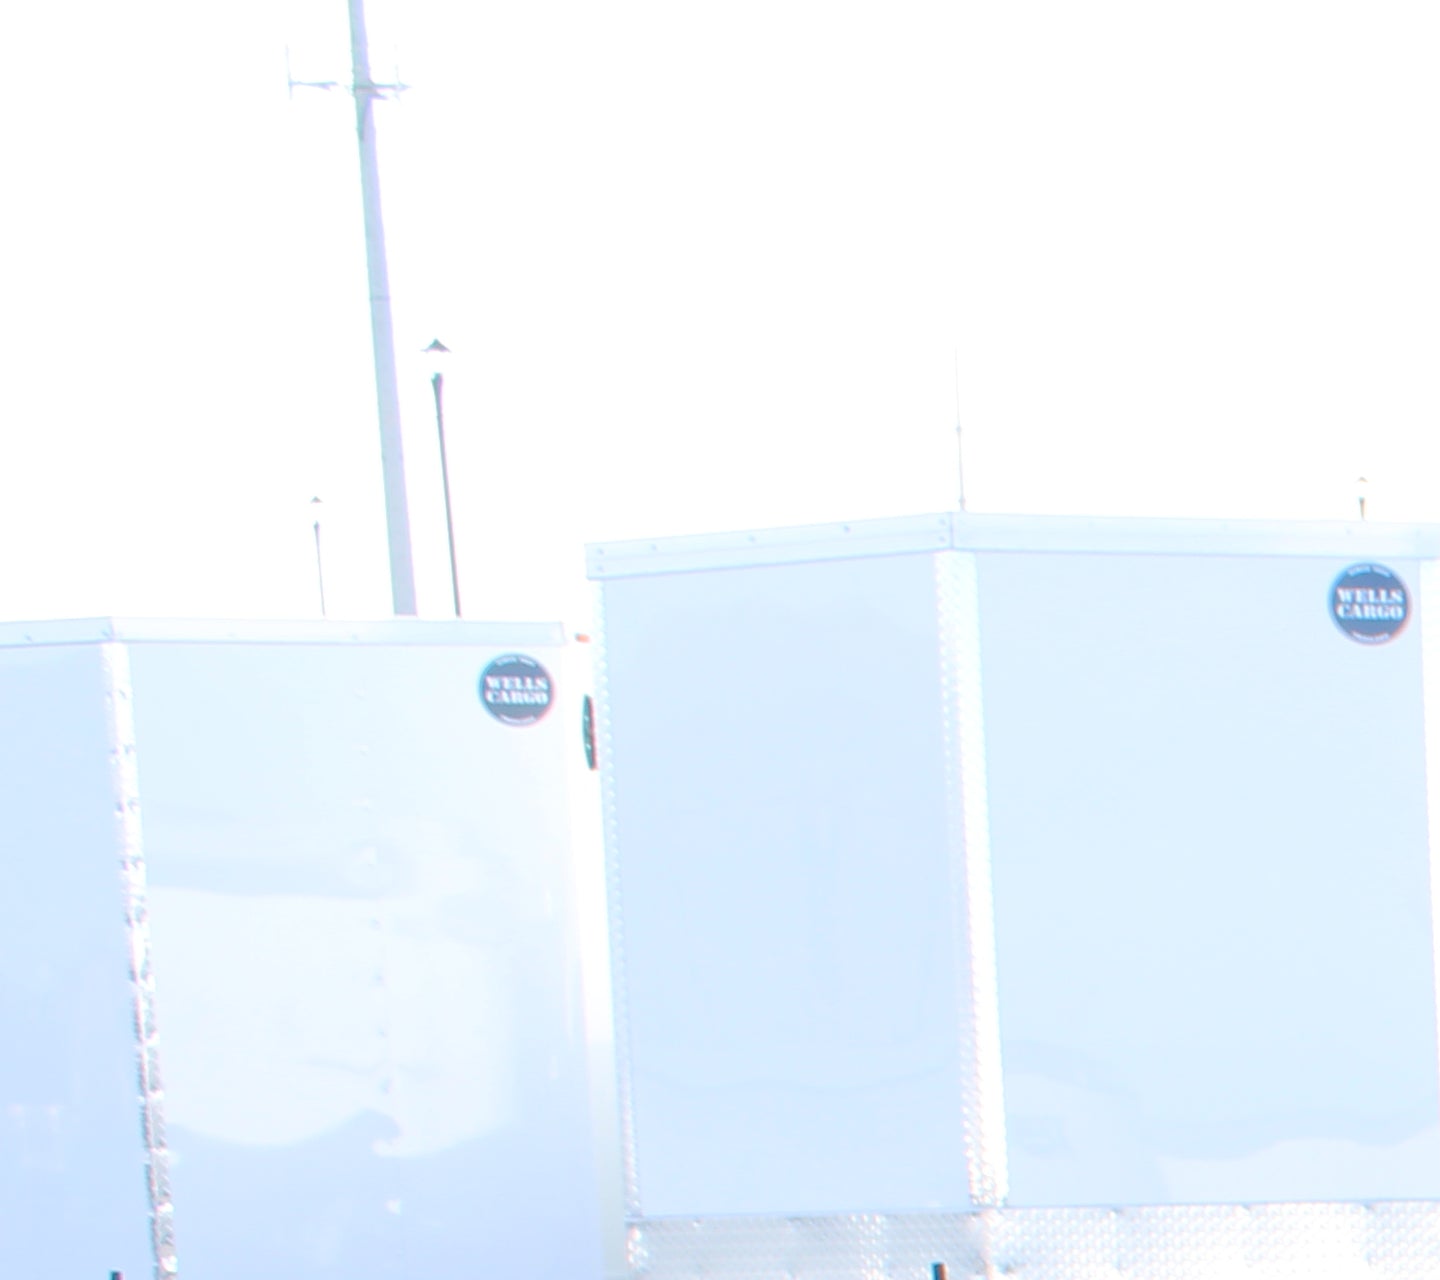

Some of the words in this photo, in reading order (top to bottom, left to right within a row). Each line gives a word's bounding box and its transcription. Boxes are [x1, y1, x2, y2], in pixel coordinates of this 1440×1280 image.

[1337, 587, 1404, 603] WELLS
[1336, 603, 1404, 620] CARGO
[485, 675, 549, 690] WELLS
[485, 690, 549, 704] CARGO
